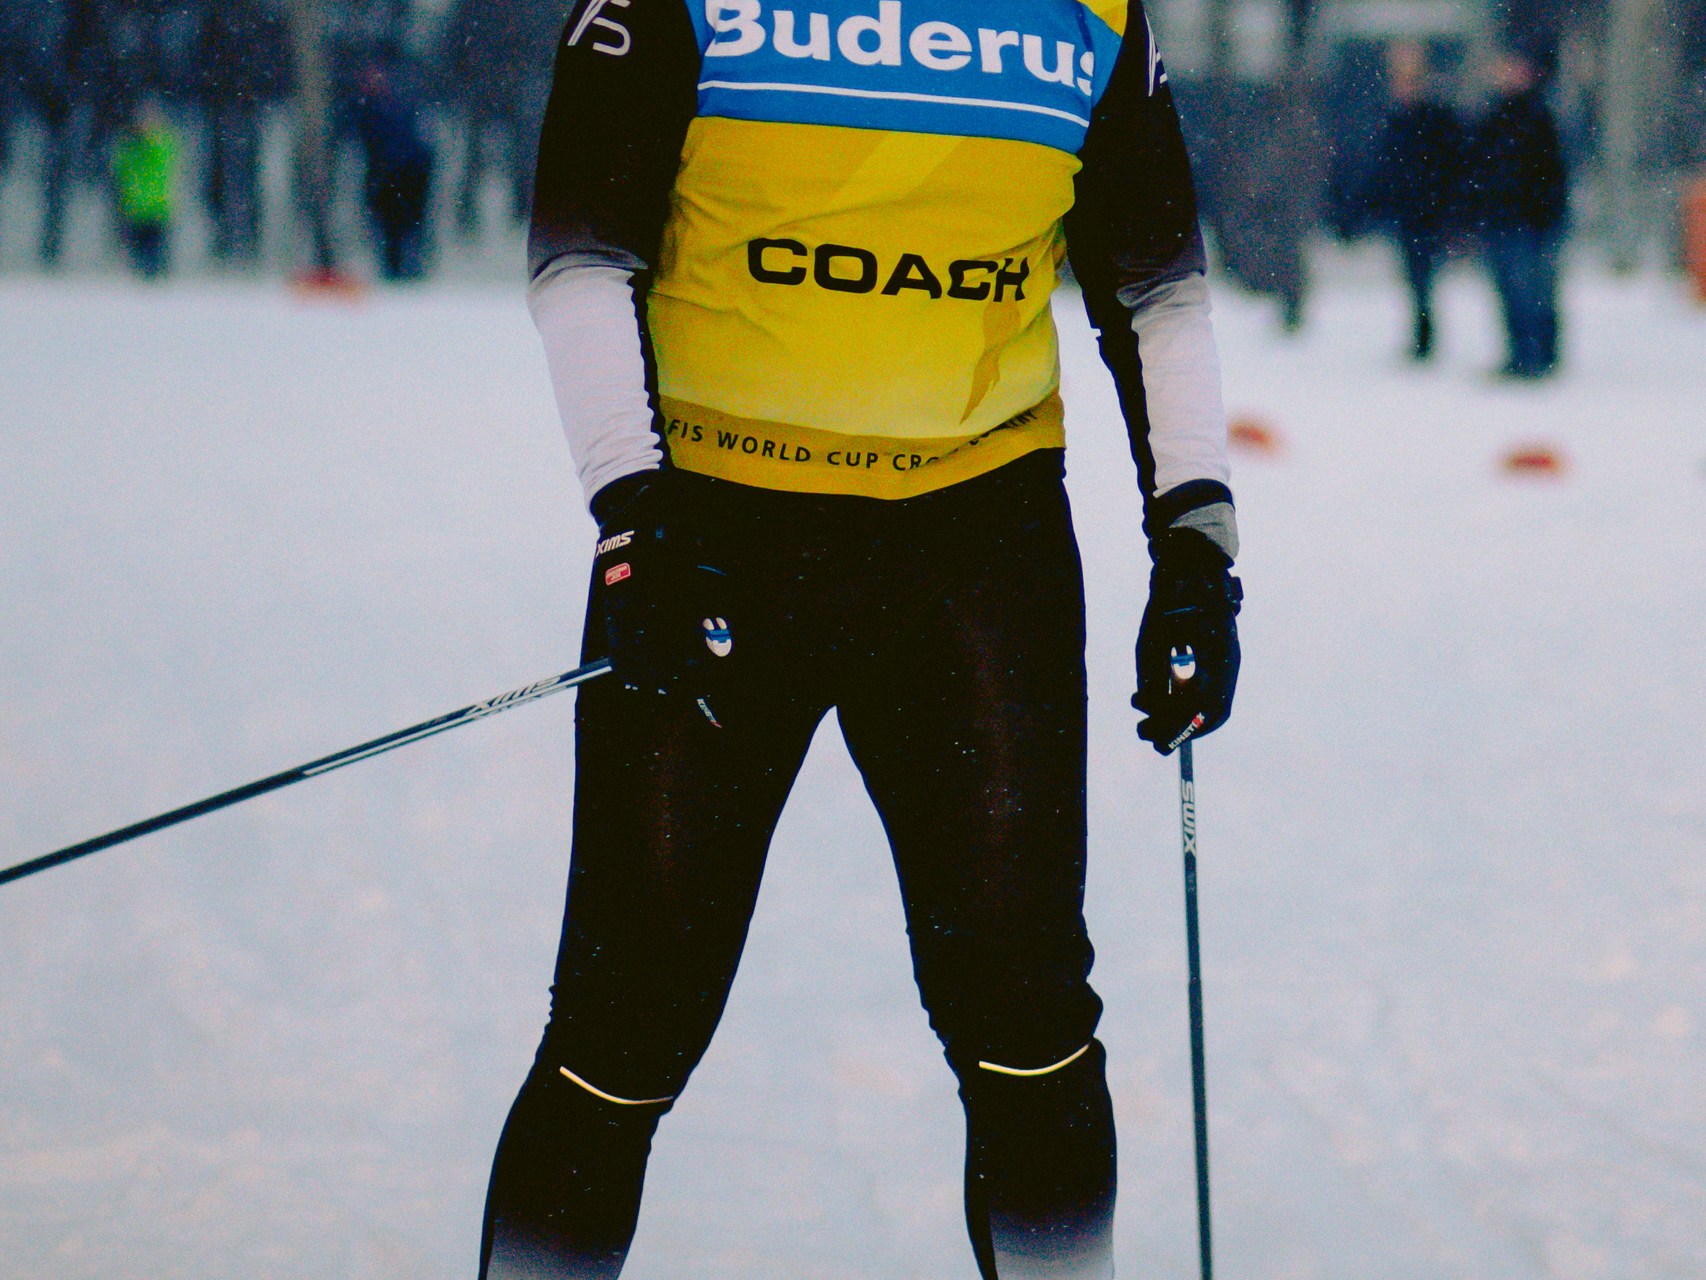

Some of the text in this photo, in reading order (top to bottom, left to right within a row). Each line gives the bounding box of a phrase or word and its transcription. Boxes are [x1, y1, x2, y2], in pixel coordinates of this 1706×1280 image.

[747, 237, 1030, 303] COACH
[668, 418, 704, 443] FIS
[717, 430, 811, 462] WORLD
[827, 451, 878, 469] CUP
[1181, 778, 1197, 857] SWIX
